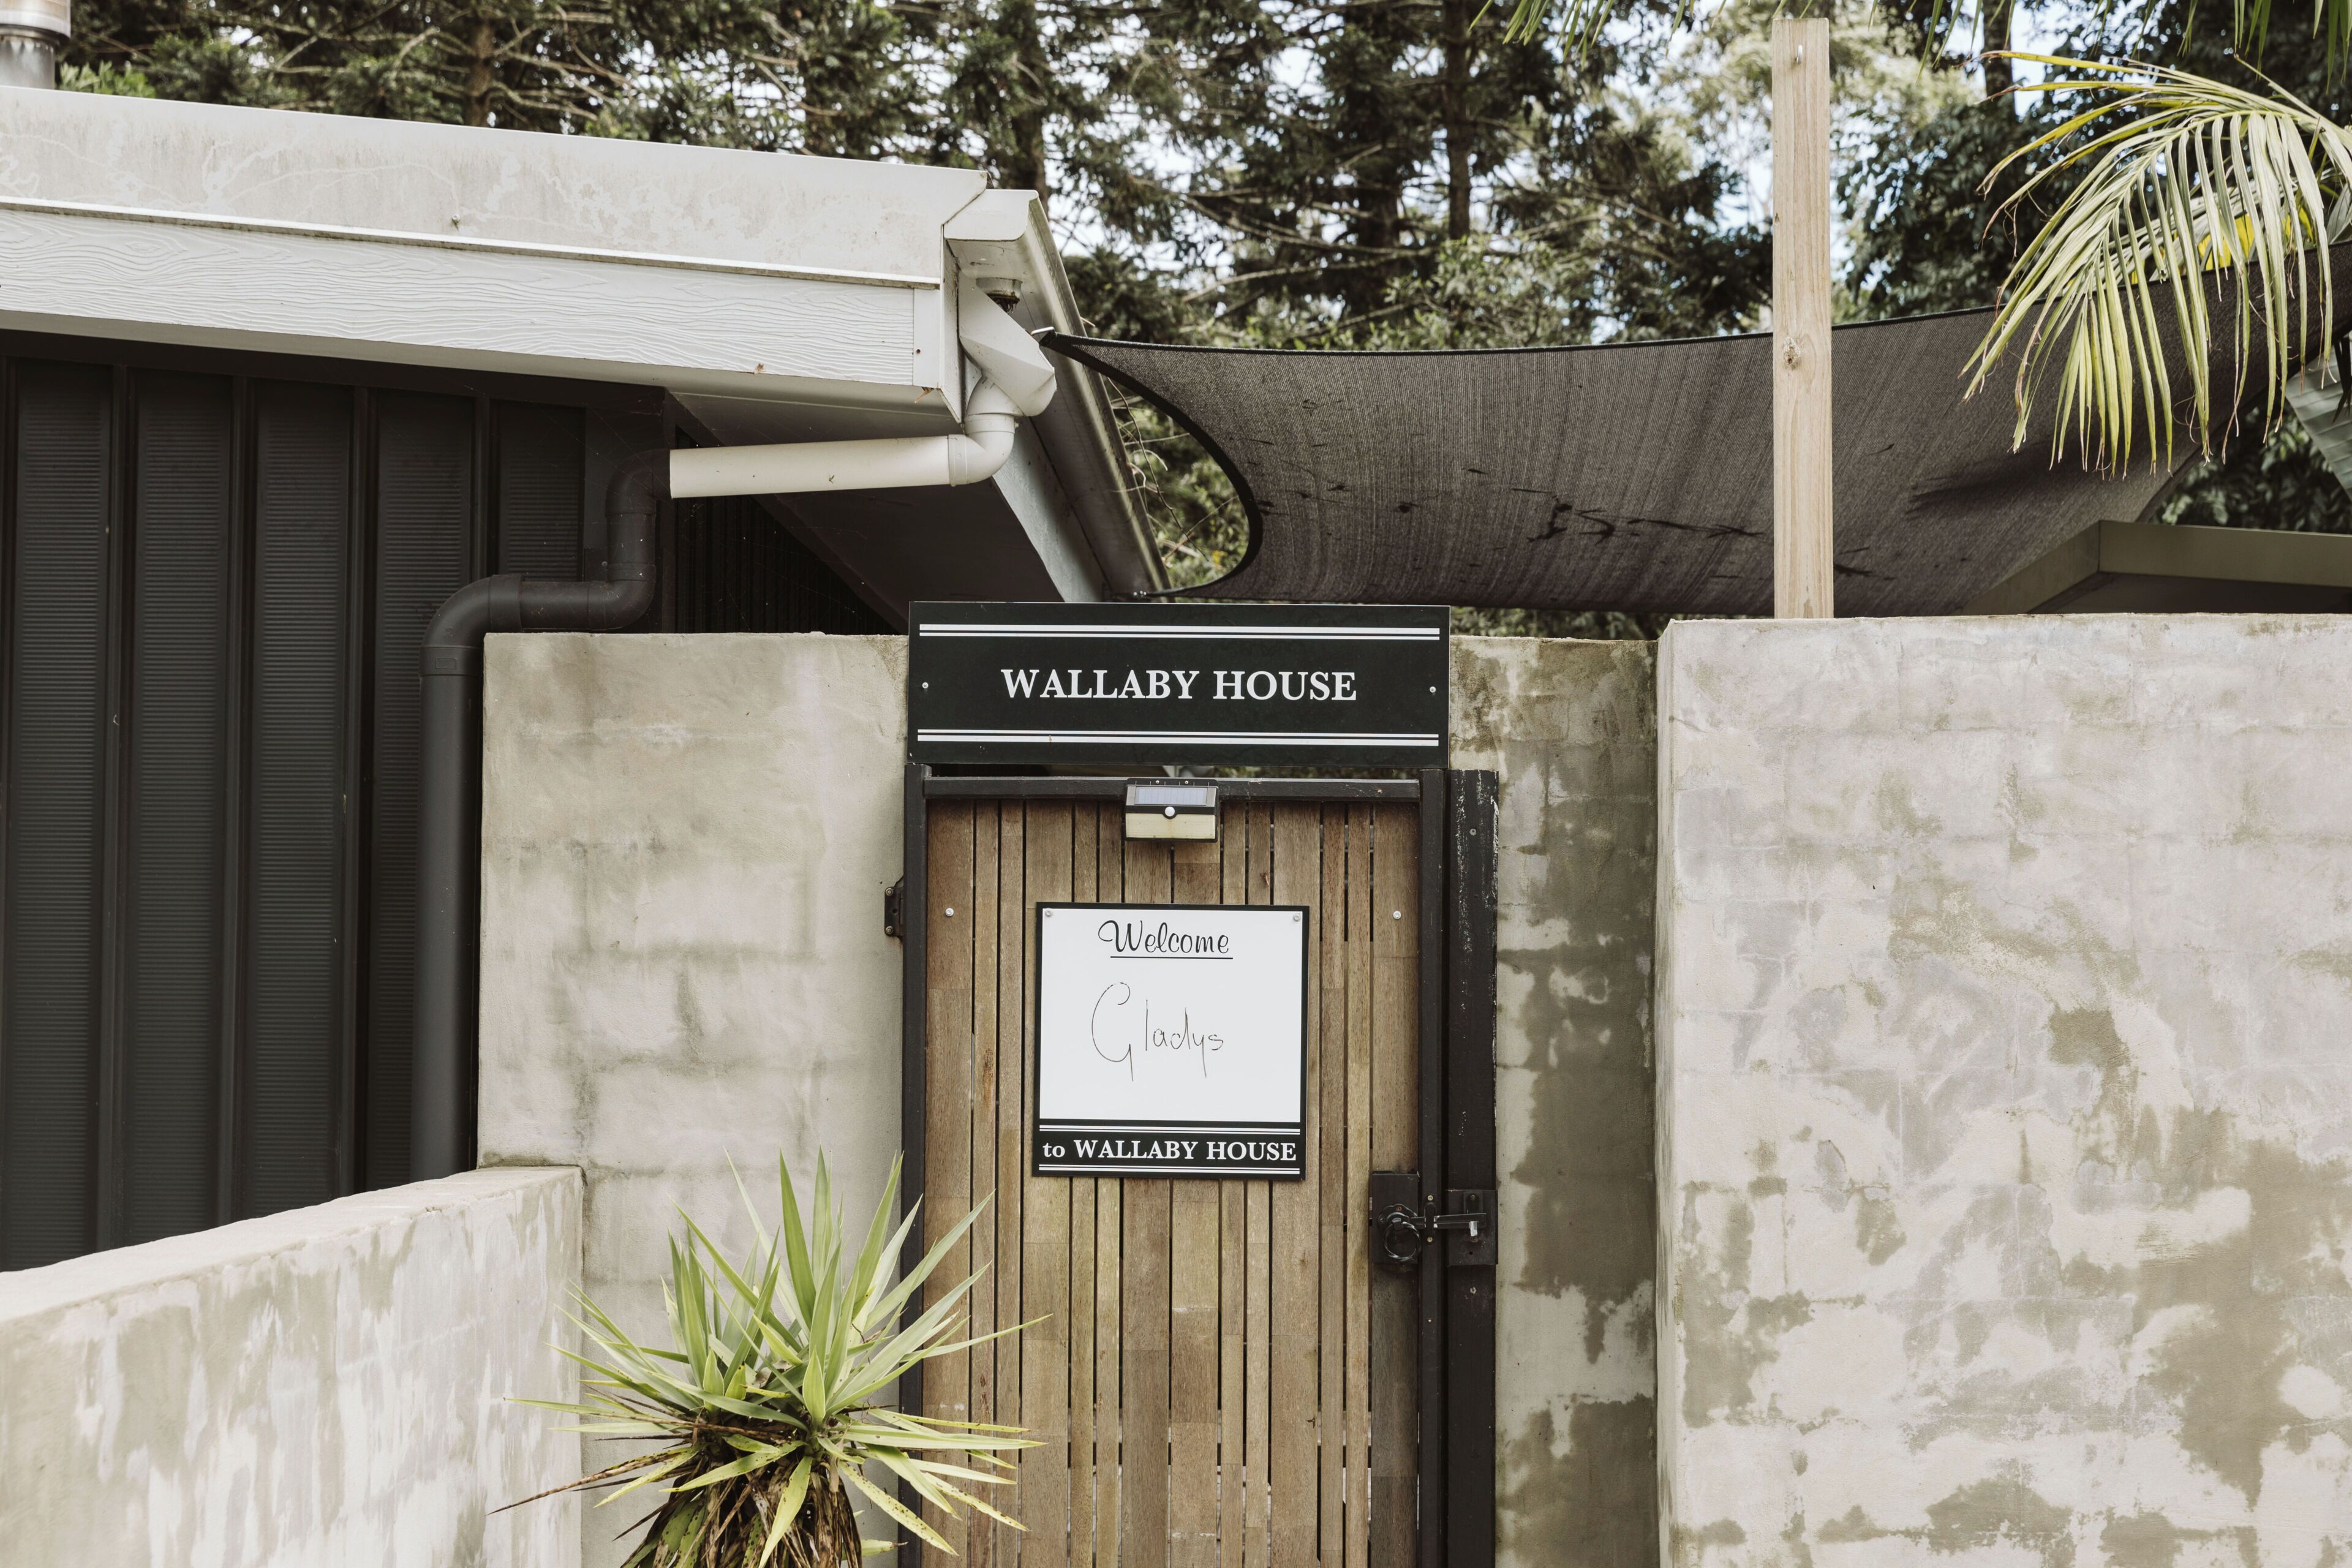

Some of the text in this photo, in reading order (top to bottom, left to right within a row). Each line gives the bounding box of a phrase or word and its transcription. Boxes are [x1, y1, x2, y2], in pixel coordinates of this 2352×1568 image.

[1000, 669, 1357, 701] WALLABY HOUSE
[1098, 919, 1229, 954] Welcome
[1091, 982, 1224, 1082] Gladys
[1042, 1139, 1297, 1161] to WALLABY HOUSE
